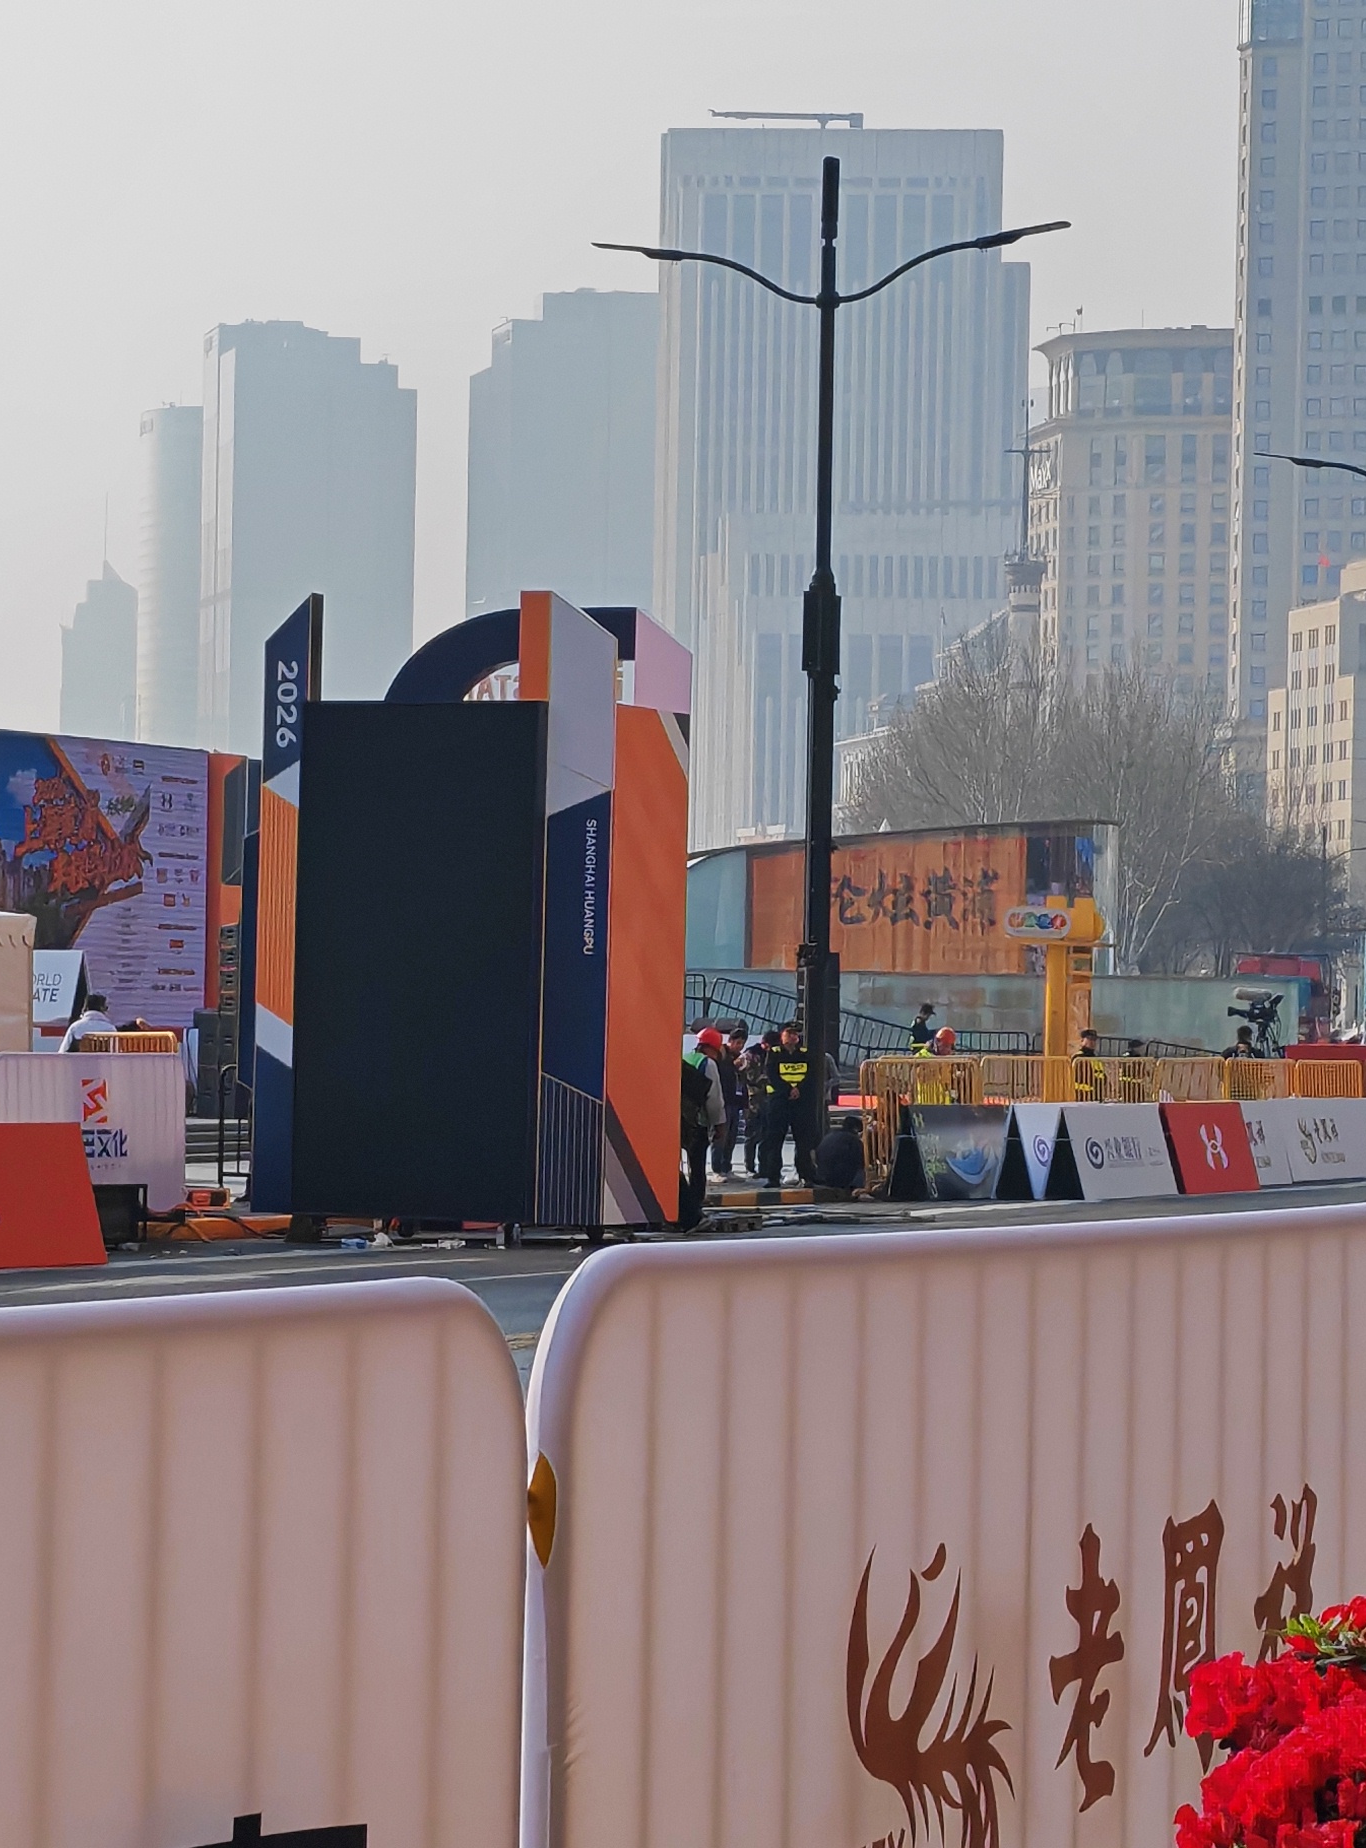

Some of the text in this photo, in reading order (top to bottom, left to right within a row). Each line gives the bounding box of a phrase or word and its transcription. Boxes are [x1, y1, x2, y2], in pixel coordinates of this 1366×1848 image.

[276, 660, 299, 748] 2026
[583, 819, 597, 955] SHANGHAI HUANGPU
